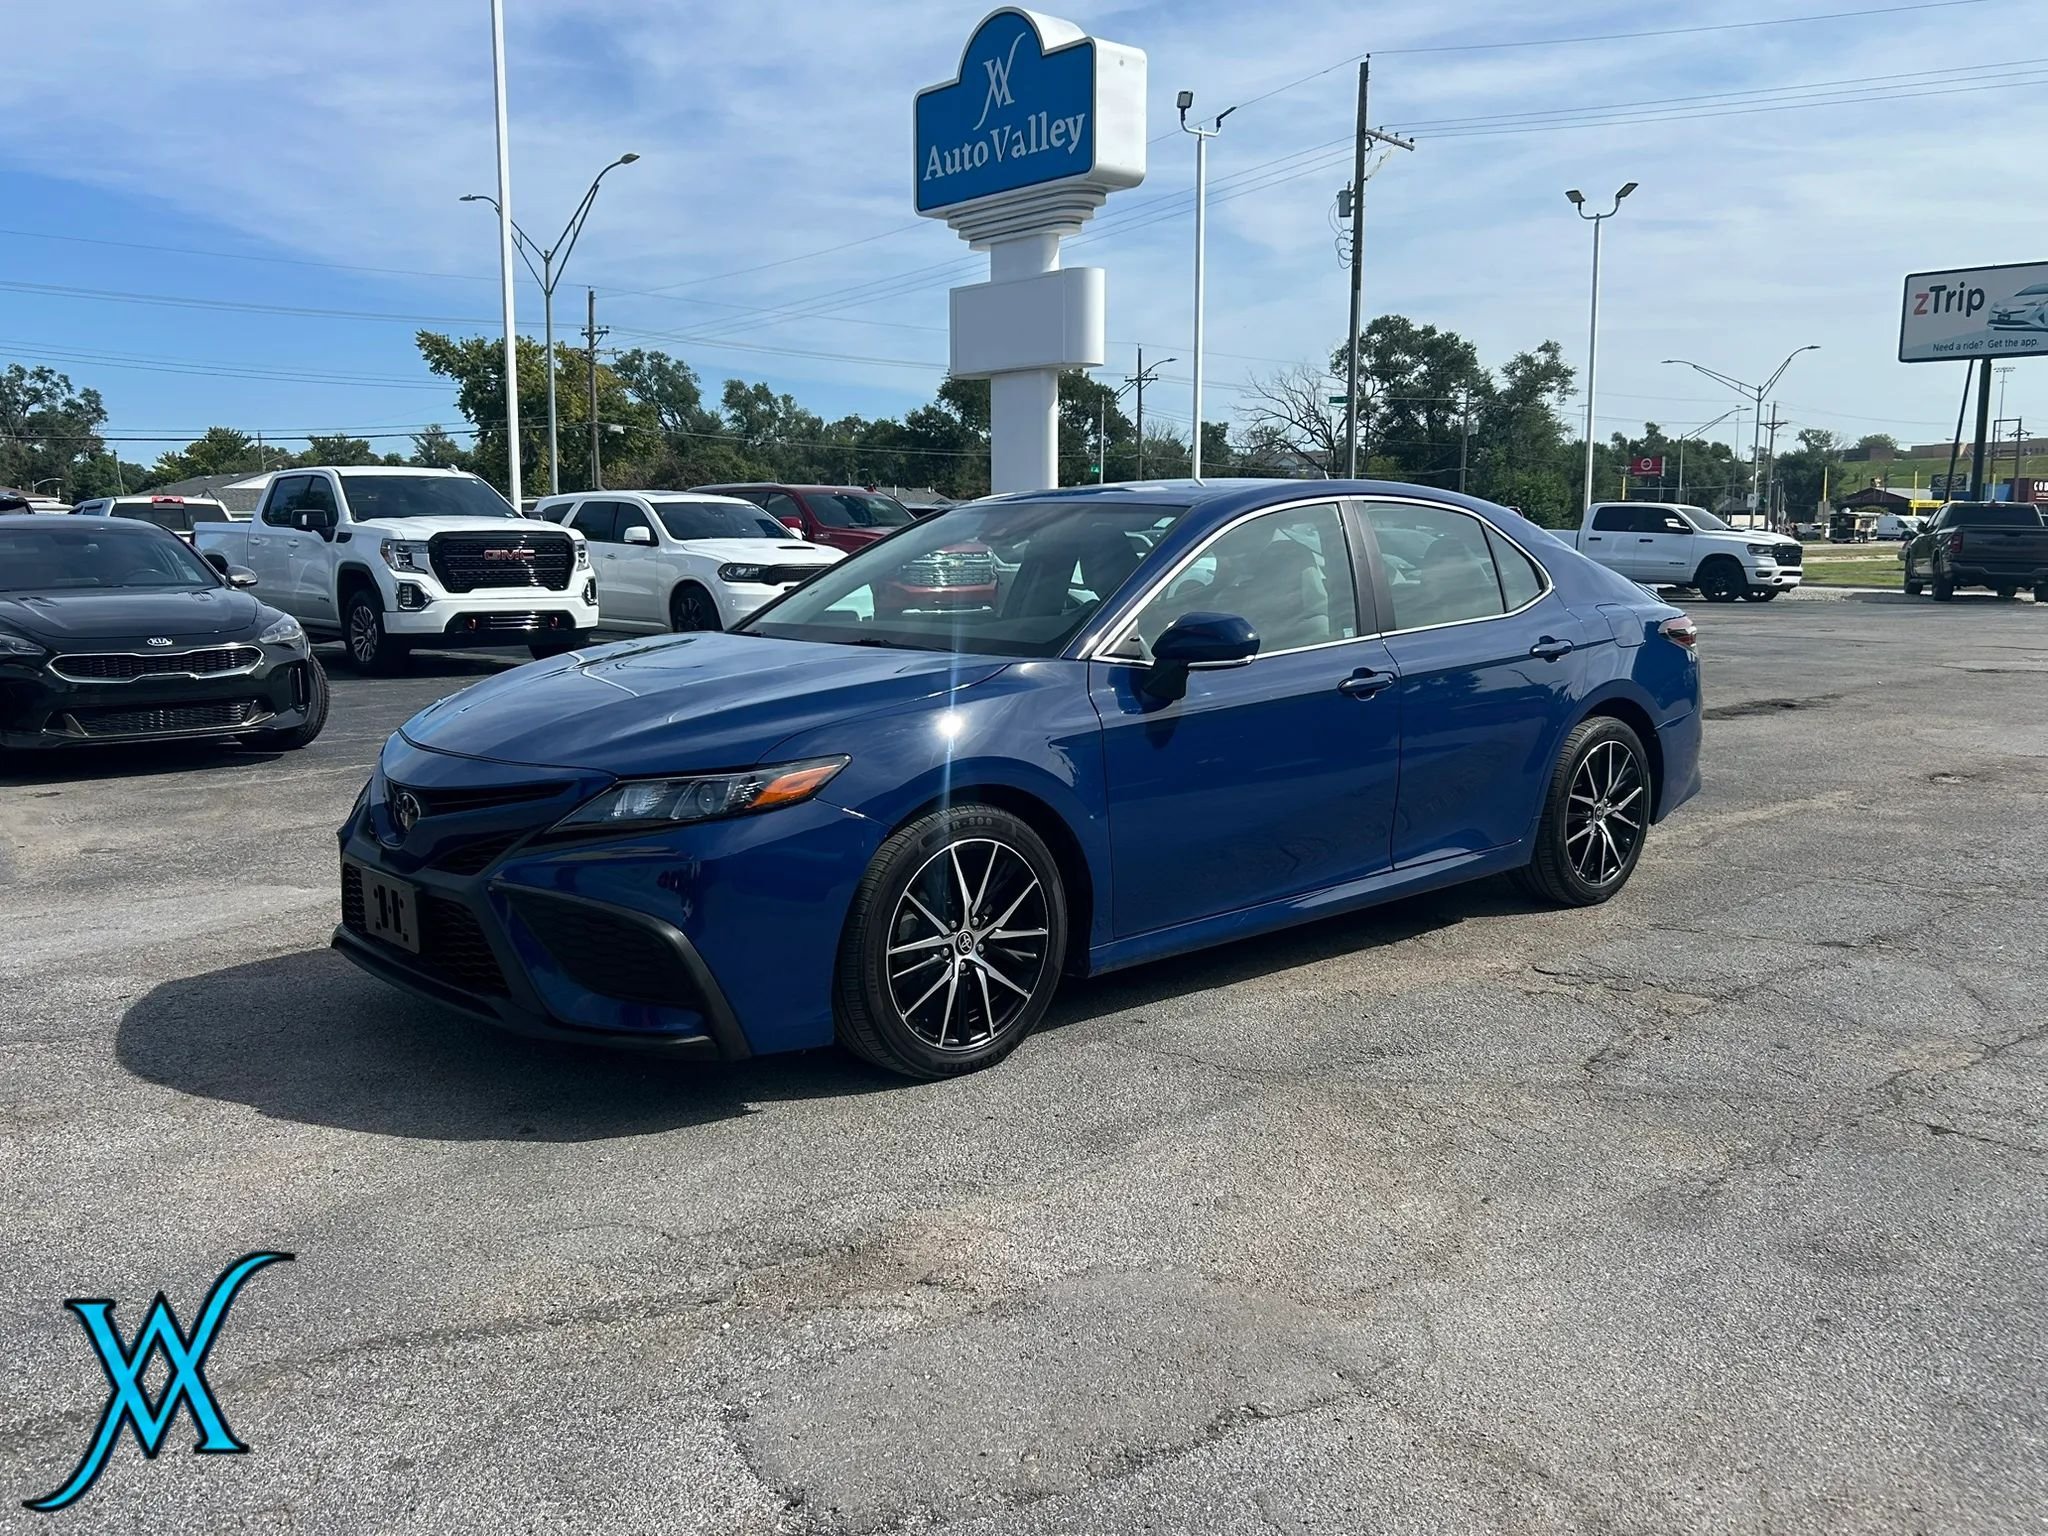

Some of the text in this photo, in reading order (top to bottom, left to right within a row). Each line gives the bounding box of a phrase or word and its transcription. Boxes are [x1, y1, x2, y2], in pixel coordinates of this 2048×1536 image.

[1913, 281, 1986, 317] zTrip
[1932, 342, 1954, 352] Need
[1963, 340, 1983, 350] ride?
[1987, 339, 2002, 349] Get
[2004, 338, 2018, 347] the
[2020, 338, 2039, 348] app.
[484, 549, 536, 560] GMC
